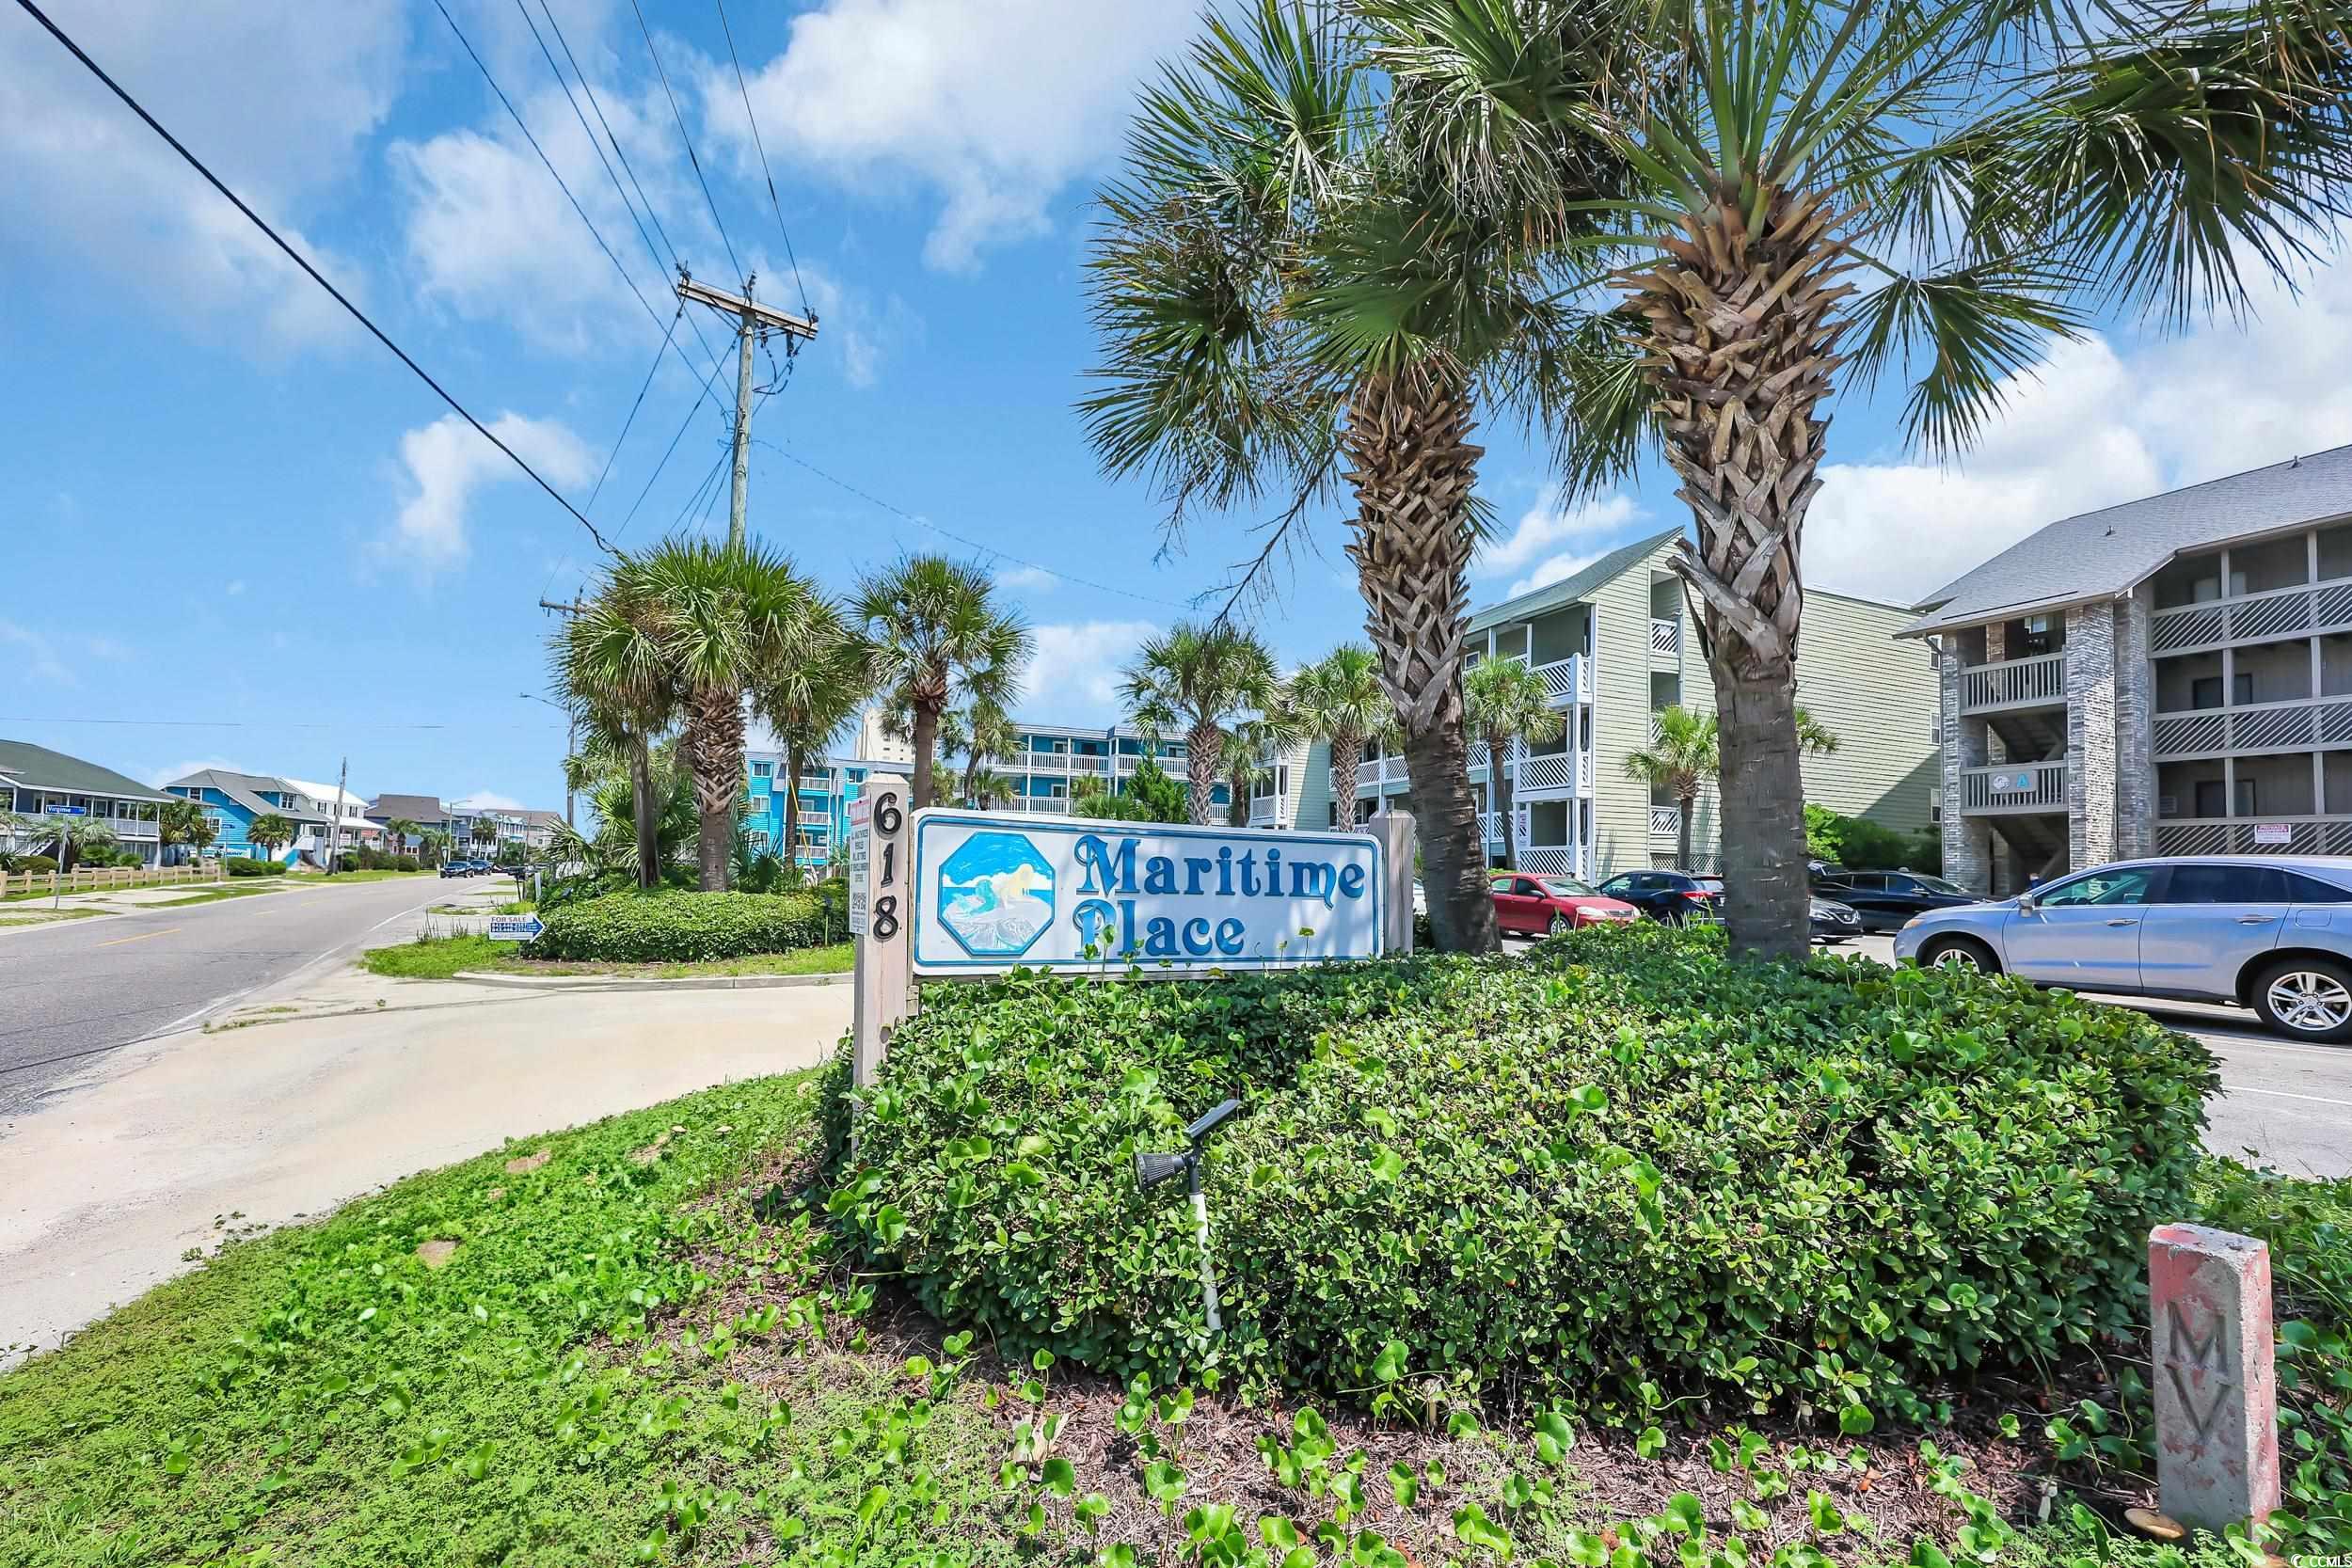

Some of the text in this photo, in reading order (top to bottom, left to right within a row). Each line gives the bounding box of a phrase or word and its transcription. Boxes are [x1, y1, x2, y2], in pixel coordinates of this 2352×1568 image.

[873, 792, 902, 940] 618
[1073, 834, 1365, 911] Maritime
[1073, 898, 1246, 958] Place
